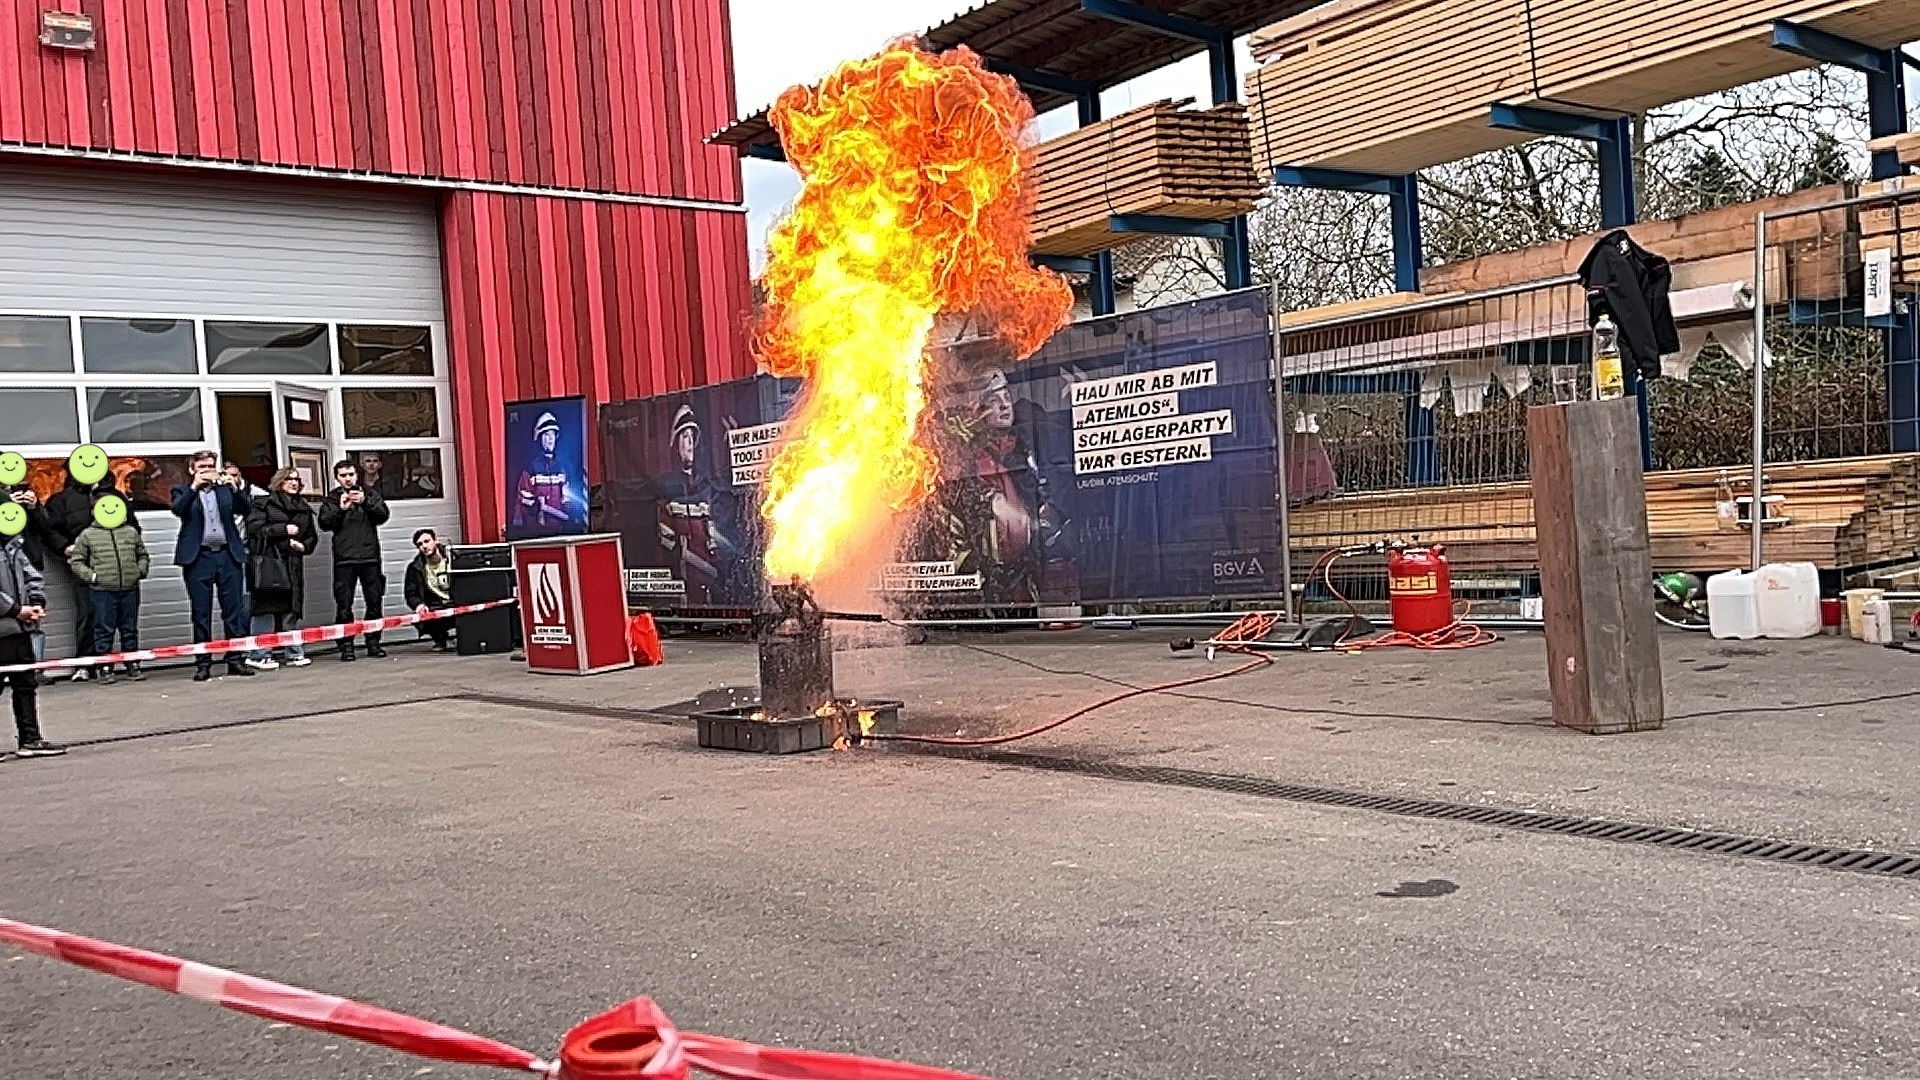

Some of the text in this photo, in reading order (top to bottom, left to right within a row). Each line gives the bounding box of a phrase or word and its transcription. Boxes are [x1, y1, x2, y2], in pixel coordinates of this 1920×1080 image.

[1076, 367, 1214, 402] HAU MIR AB MIT
[1077, 415, 1229, 448] SCHLAGERPARTY
[733, 449, 763, 464] TOOLS
[1079, 443, 1208, 471] WAR GESTERN.
[1213, 560, 1246, 577] BGV
